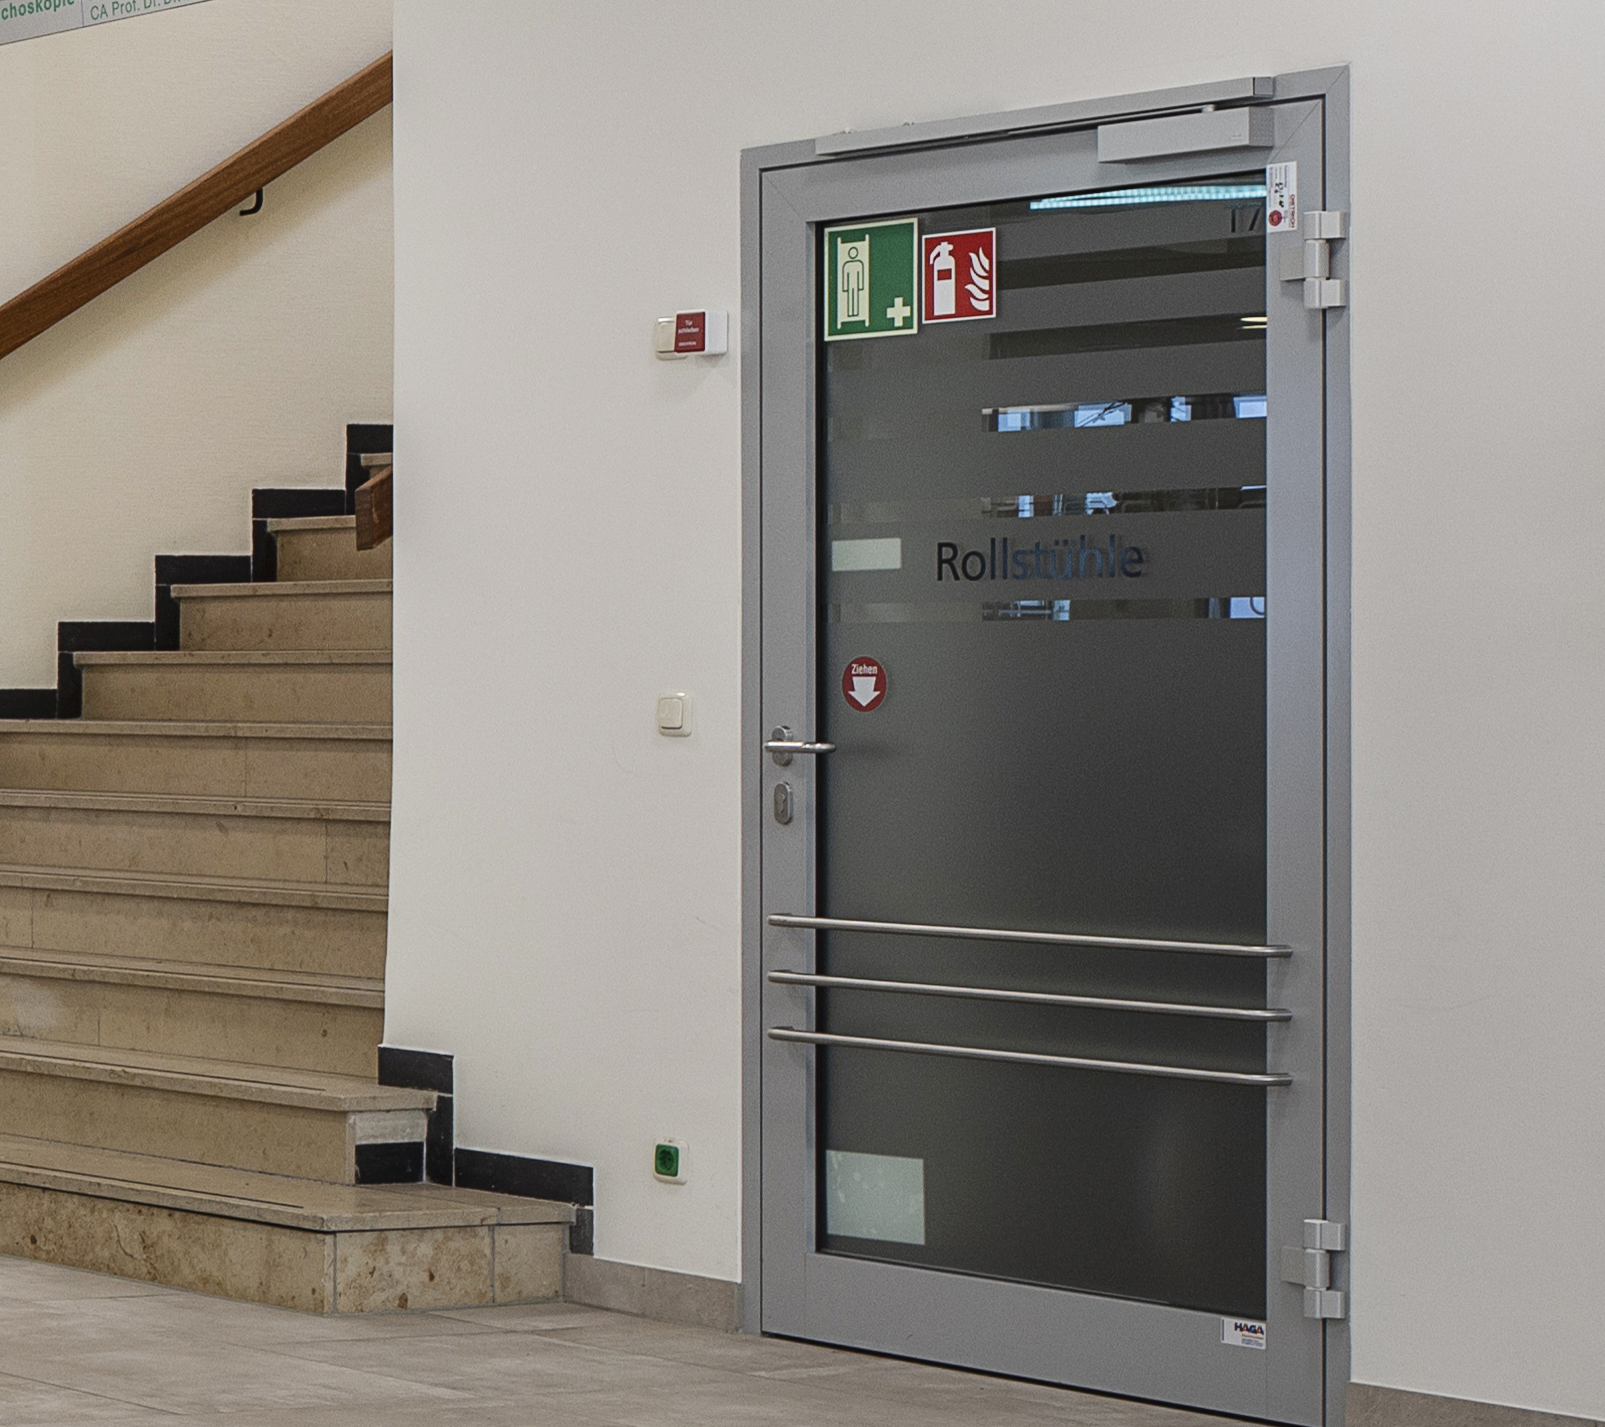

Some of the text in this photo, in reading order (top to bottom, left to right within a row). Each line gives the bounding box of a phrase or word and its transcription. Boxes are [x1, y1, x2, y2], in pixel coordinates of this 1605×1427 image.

[90, 4, 109, 22] CA
[936, 536, 1144, 581] Rollstühle
[851, 663, 878, 674] Ziehen
[1234, 1322, 1264, 1335] HAGA
